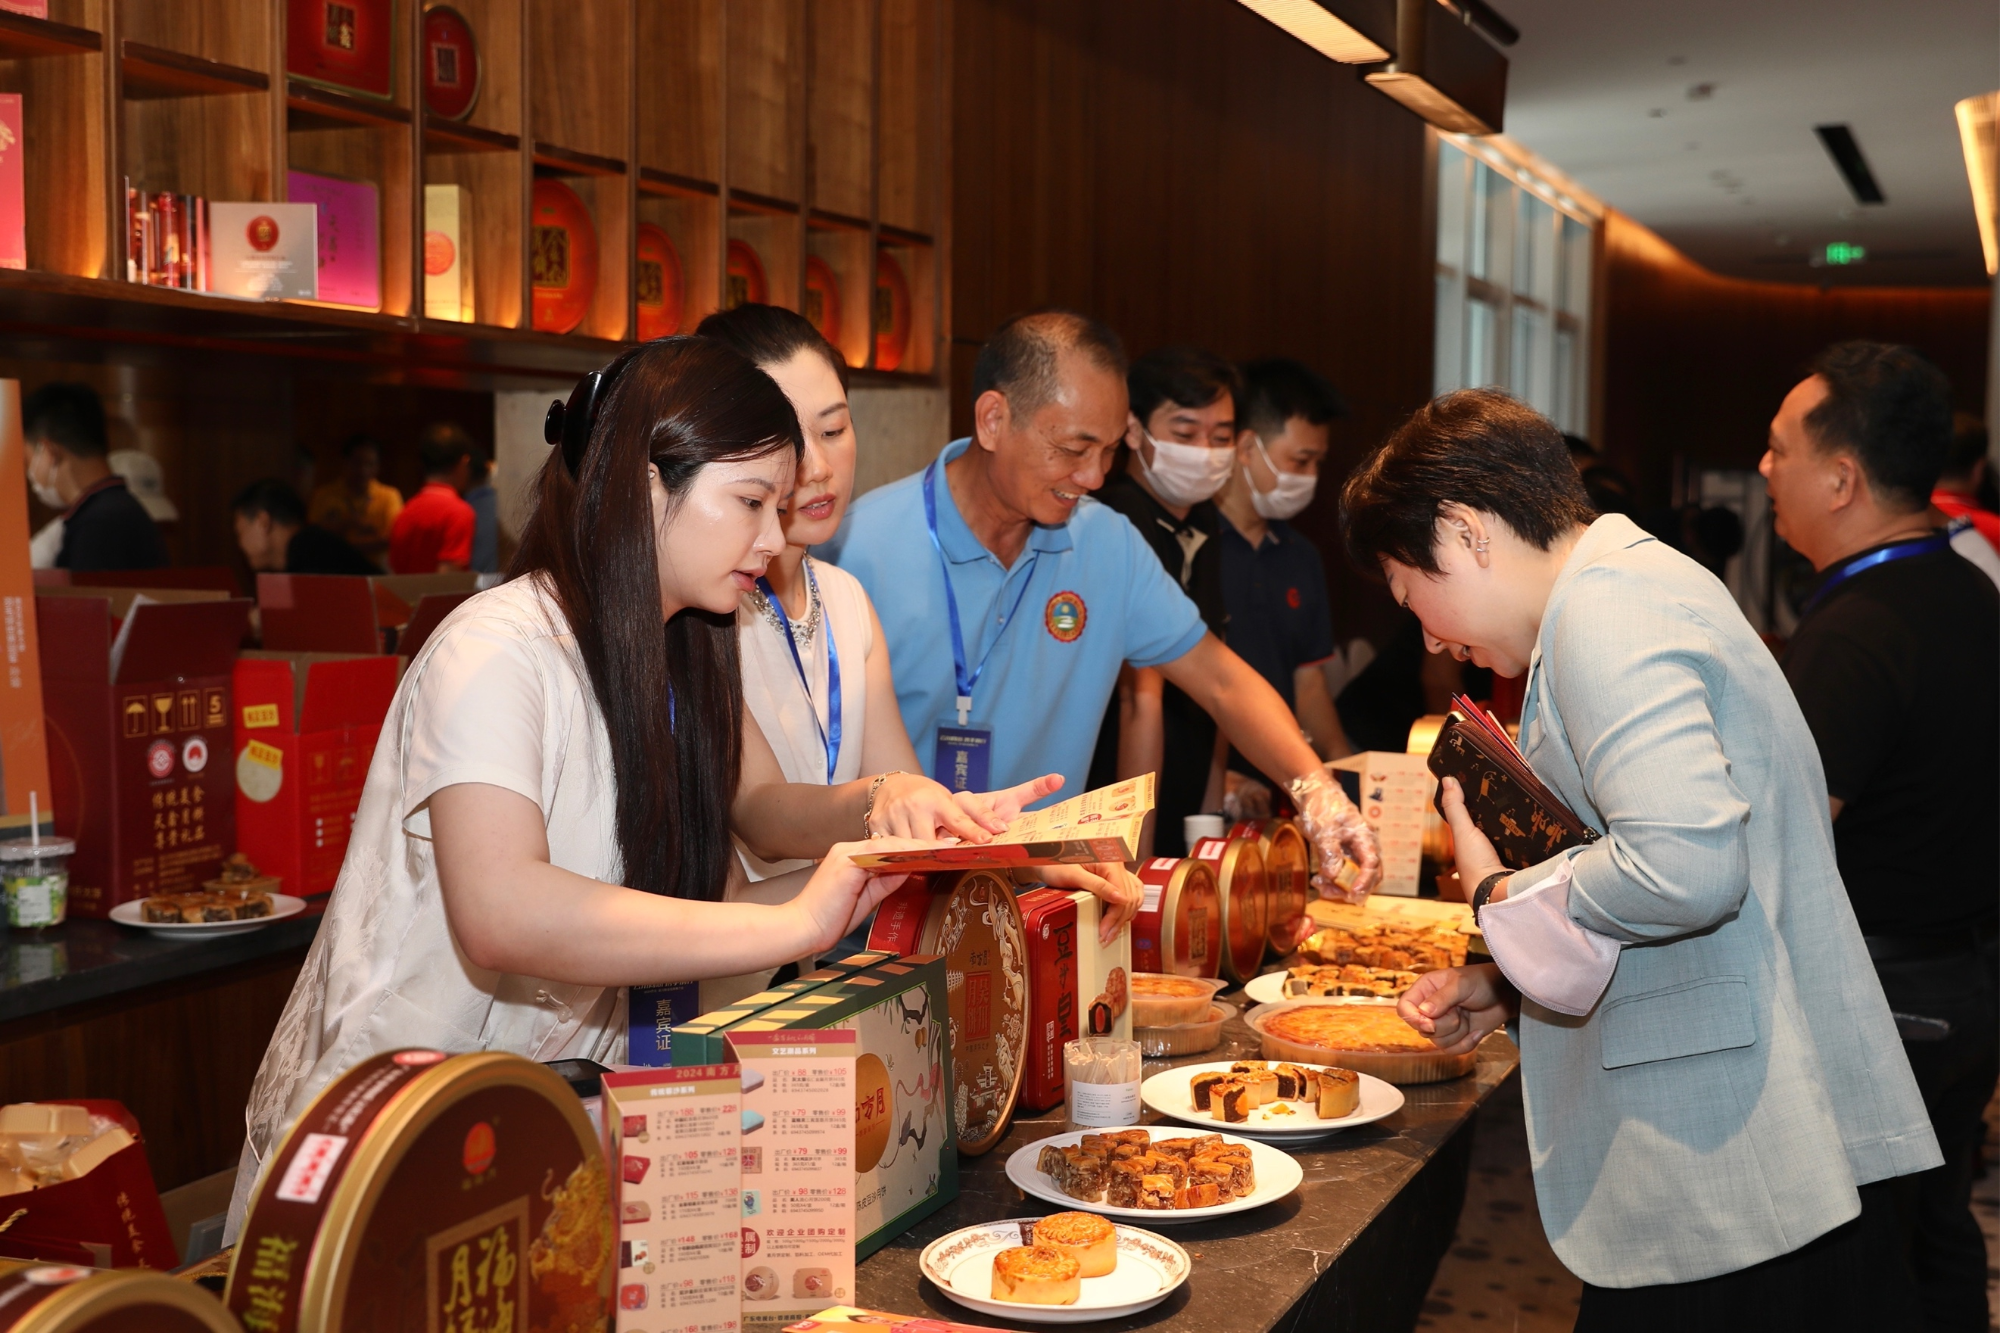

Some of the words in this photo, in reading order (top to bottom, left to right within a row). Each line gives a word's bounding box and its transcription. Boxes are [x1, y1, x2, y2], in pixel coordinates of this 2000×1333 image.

[656, 999, 671, 1050] 嘉宾证
[676, 1068, 702, 1078] 2024
[766, 1228, 846, 1236] 欢迎企业团购定制
